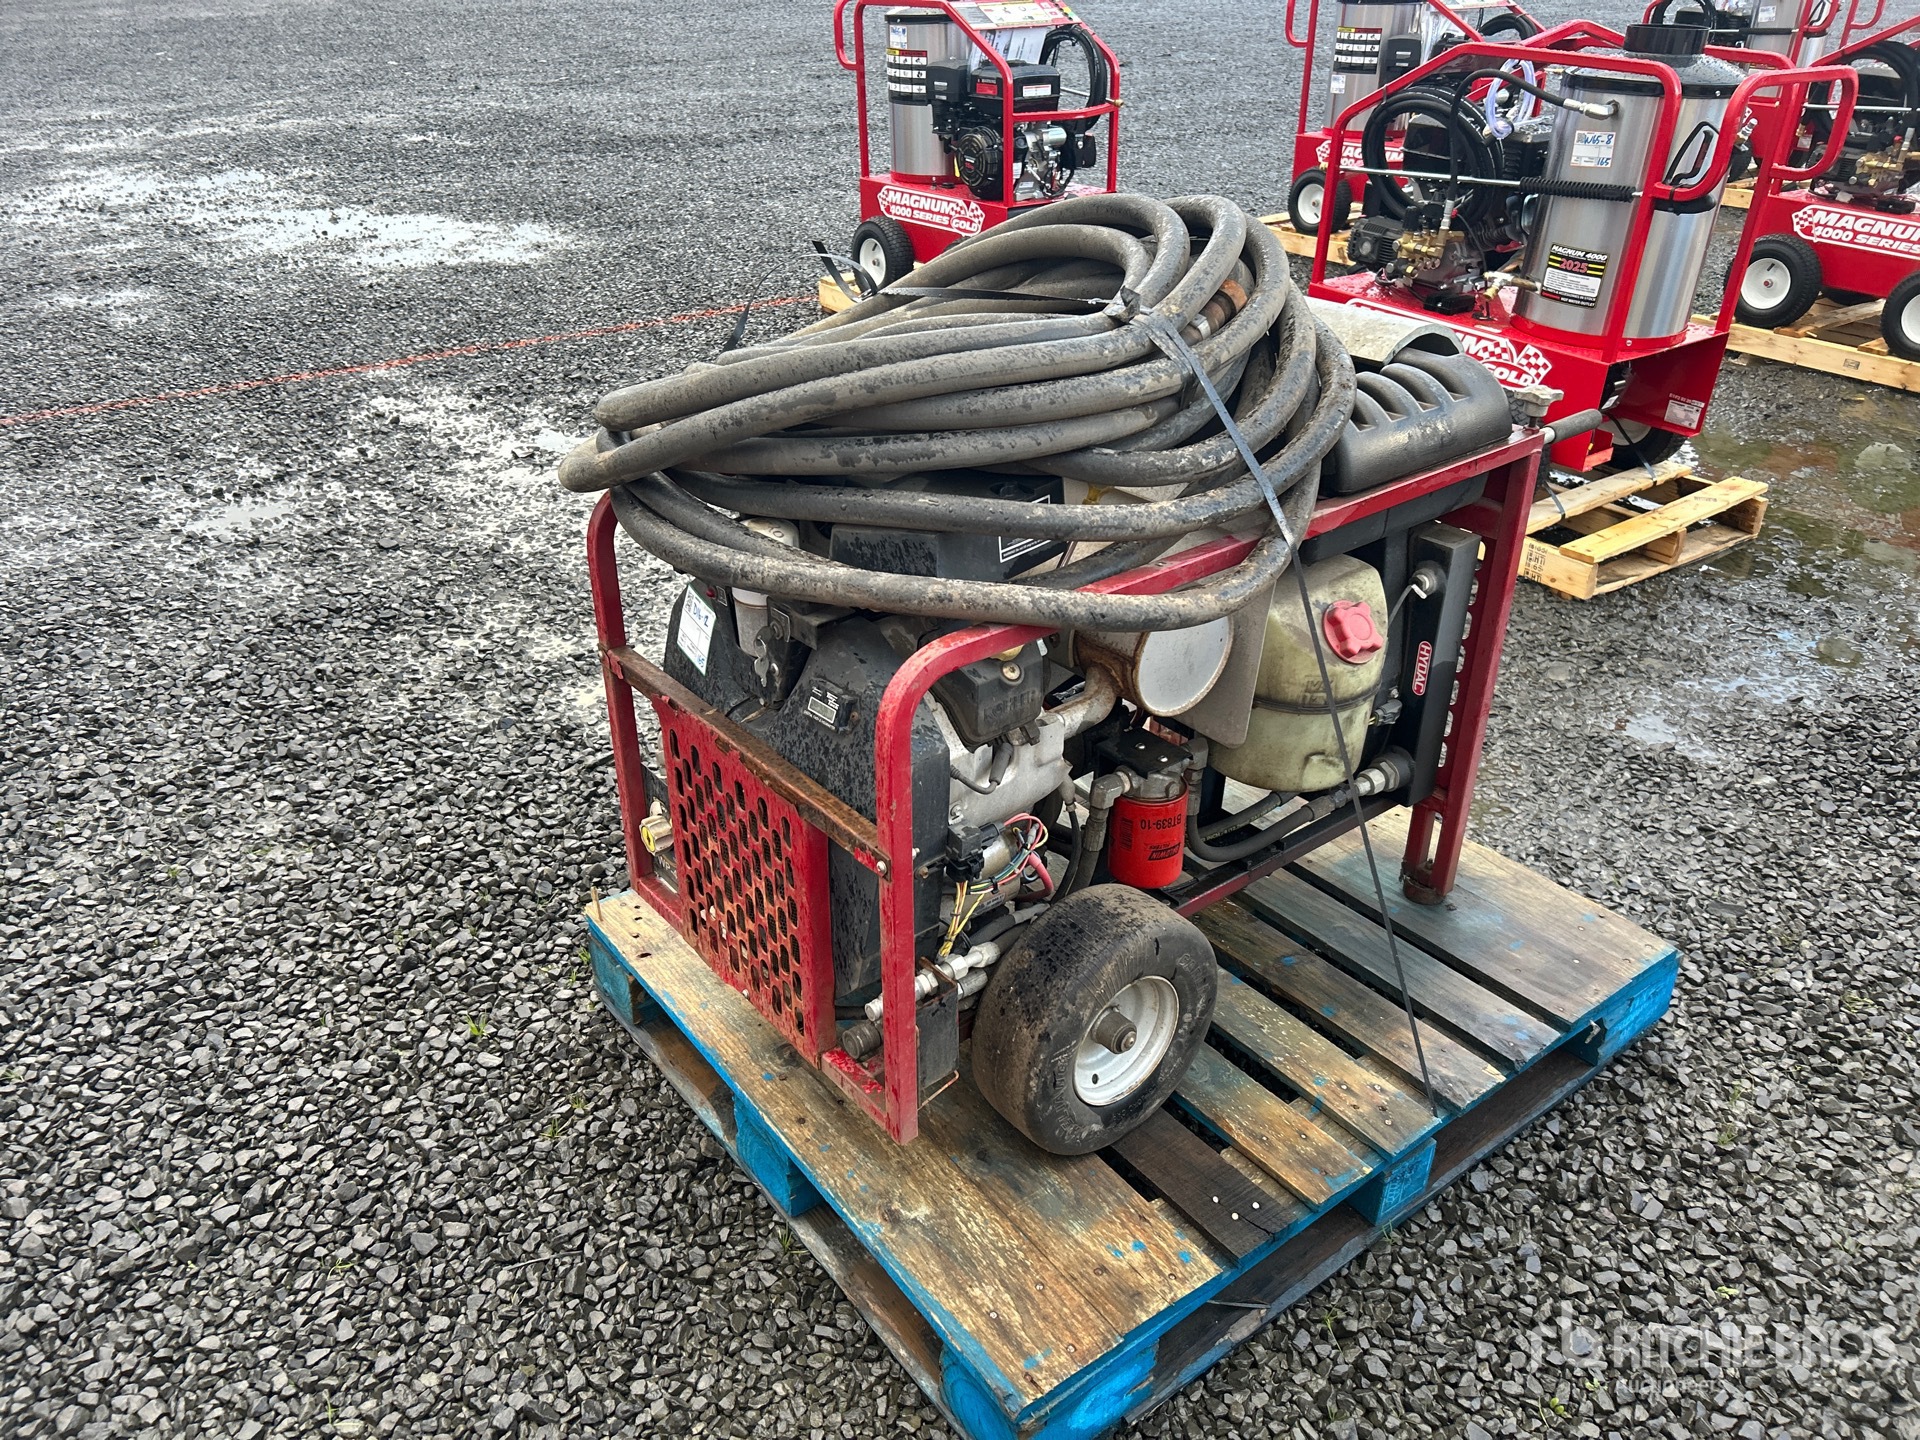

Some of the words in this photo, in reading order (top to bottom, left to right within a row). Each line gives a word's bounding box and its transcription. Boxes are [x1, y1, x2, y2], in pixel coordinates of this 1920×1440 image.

[1597, 157, 1611, 166] 165
[888, 190, 953, 215] MAGNUM
[889, 204, 912, 218] 4000
[912, 210, 950, 225] SERIES
[952, 219, 978, 233] GOLD
[1812, 225, 1854, 242] 4000
[1552, 245, 1586, 257] MAGNUM
[1585, 253, 1608, 261] 4000
[1559, 258, 1588, 273] 2025
[1414, 644, 1431, 693] HYDAC
[1140, 813, 1182, 830] BT839-10
